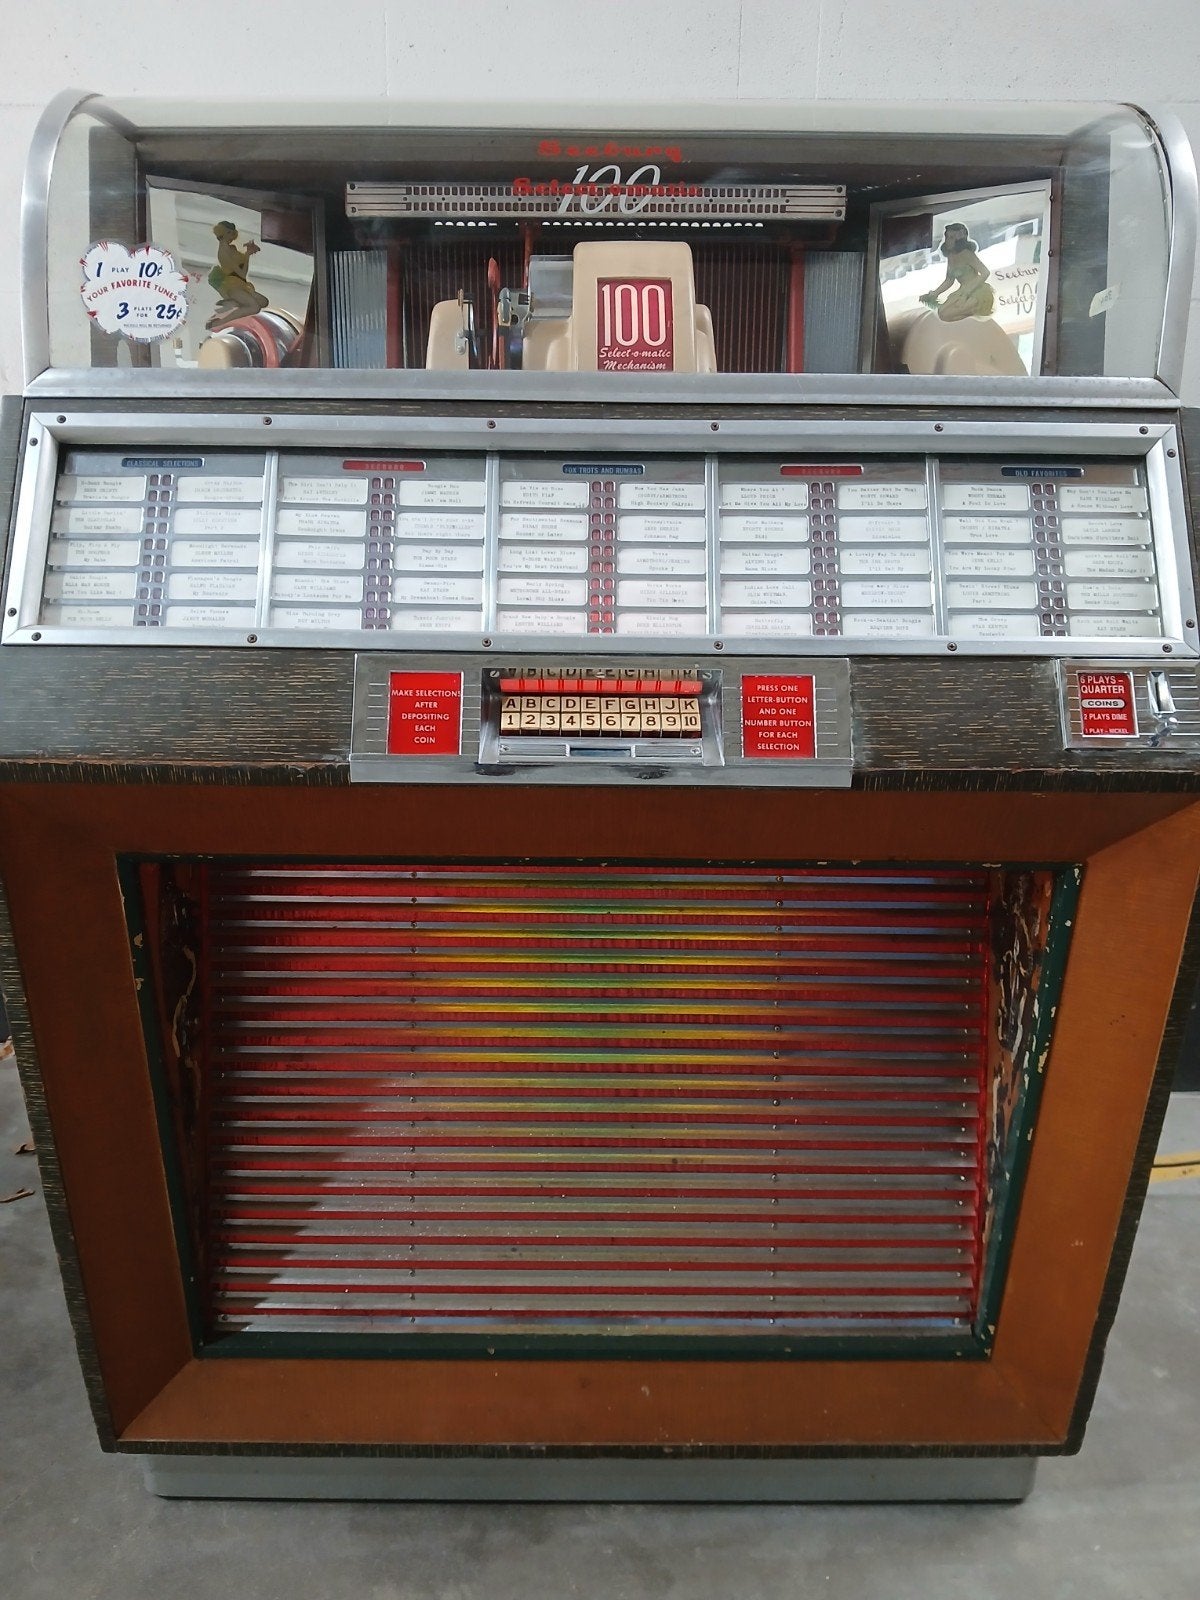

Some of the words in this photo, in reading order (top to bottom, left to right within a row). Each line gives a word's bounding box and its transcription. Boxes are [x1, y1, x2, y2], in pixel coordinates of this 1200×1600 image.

[96, 262, 103, 278] 1
[86, 286, 109, 303] YOUR
[110, 278, 152, 290] FAVORITE
[153, 284, 179, 302] TUNES
[116, 302, 130, 320] 3
[601, 284, 667, 347] 100
[603, 359, 667, 371] Mechanism
[600, 467, 614, 475] AND
[615, 467, 642, 475] RUMBAS
[1088, 676, 1116, 684] PLAYS
[1081, 685, 1124, 693] QUARTER
[507, 699, 515, 708] A
[526, 699, 536, 708] B
[546, 699, 556, 708] C
[566, 699, 576, 708] D
[586, 699, 596, 708] E
[606, 699, 615, 709] F
[625, 699, 636, 709] G
[646, 699, 656, 709] H
[665, 699, 675, 709] J
[684, 700, 695, 709] K
[507, 715, 513, 725] 1
[525, 715, 535, 725] 2
[546, 715, 556, 726] 3
[566, 715, 576, 726] 4
[586, 715, 595, 726] 5
[606, 715, 616, 726] 6
[626, 715, 635, 726] 7
[646, 715, 656, 726] 8
[666, 716, 676, 726] 9
[684, 716, 697, 726] 10
